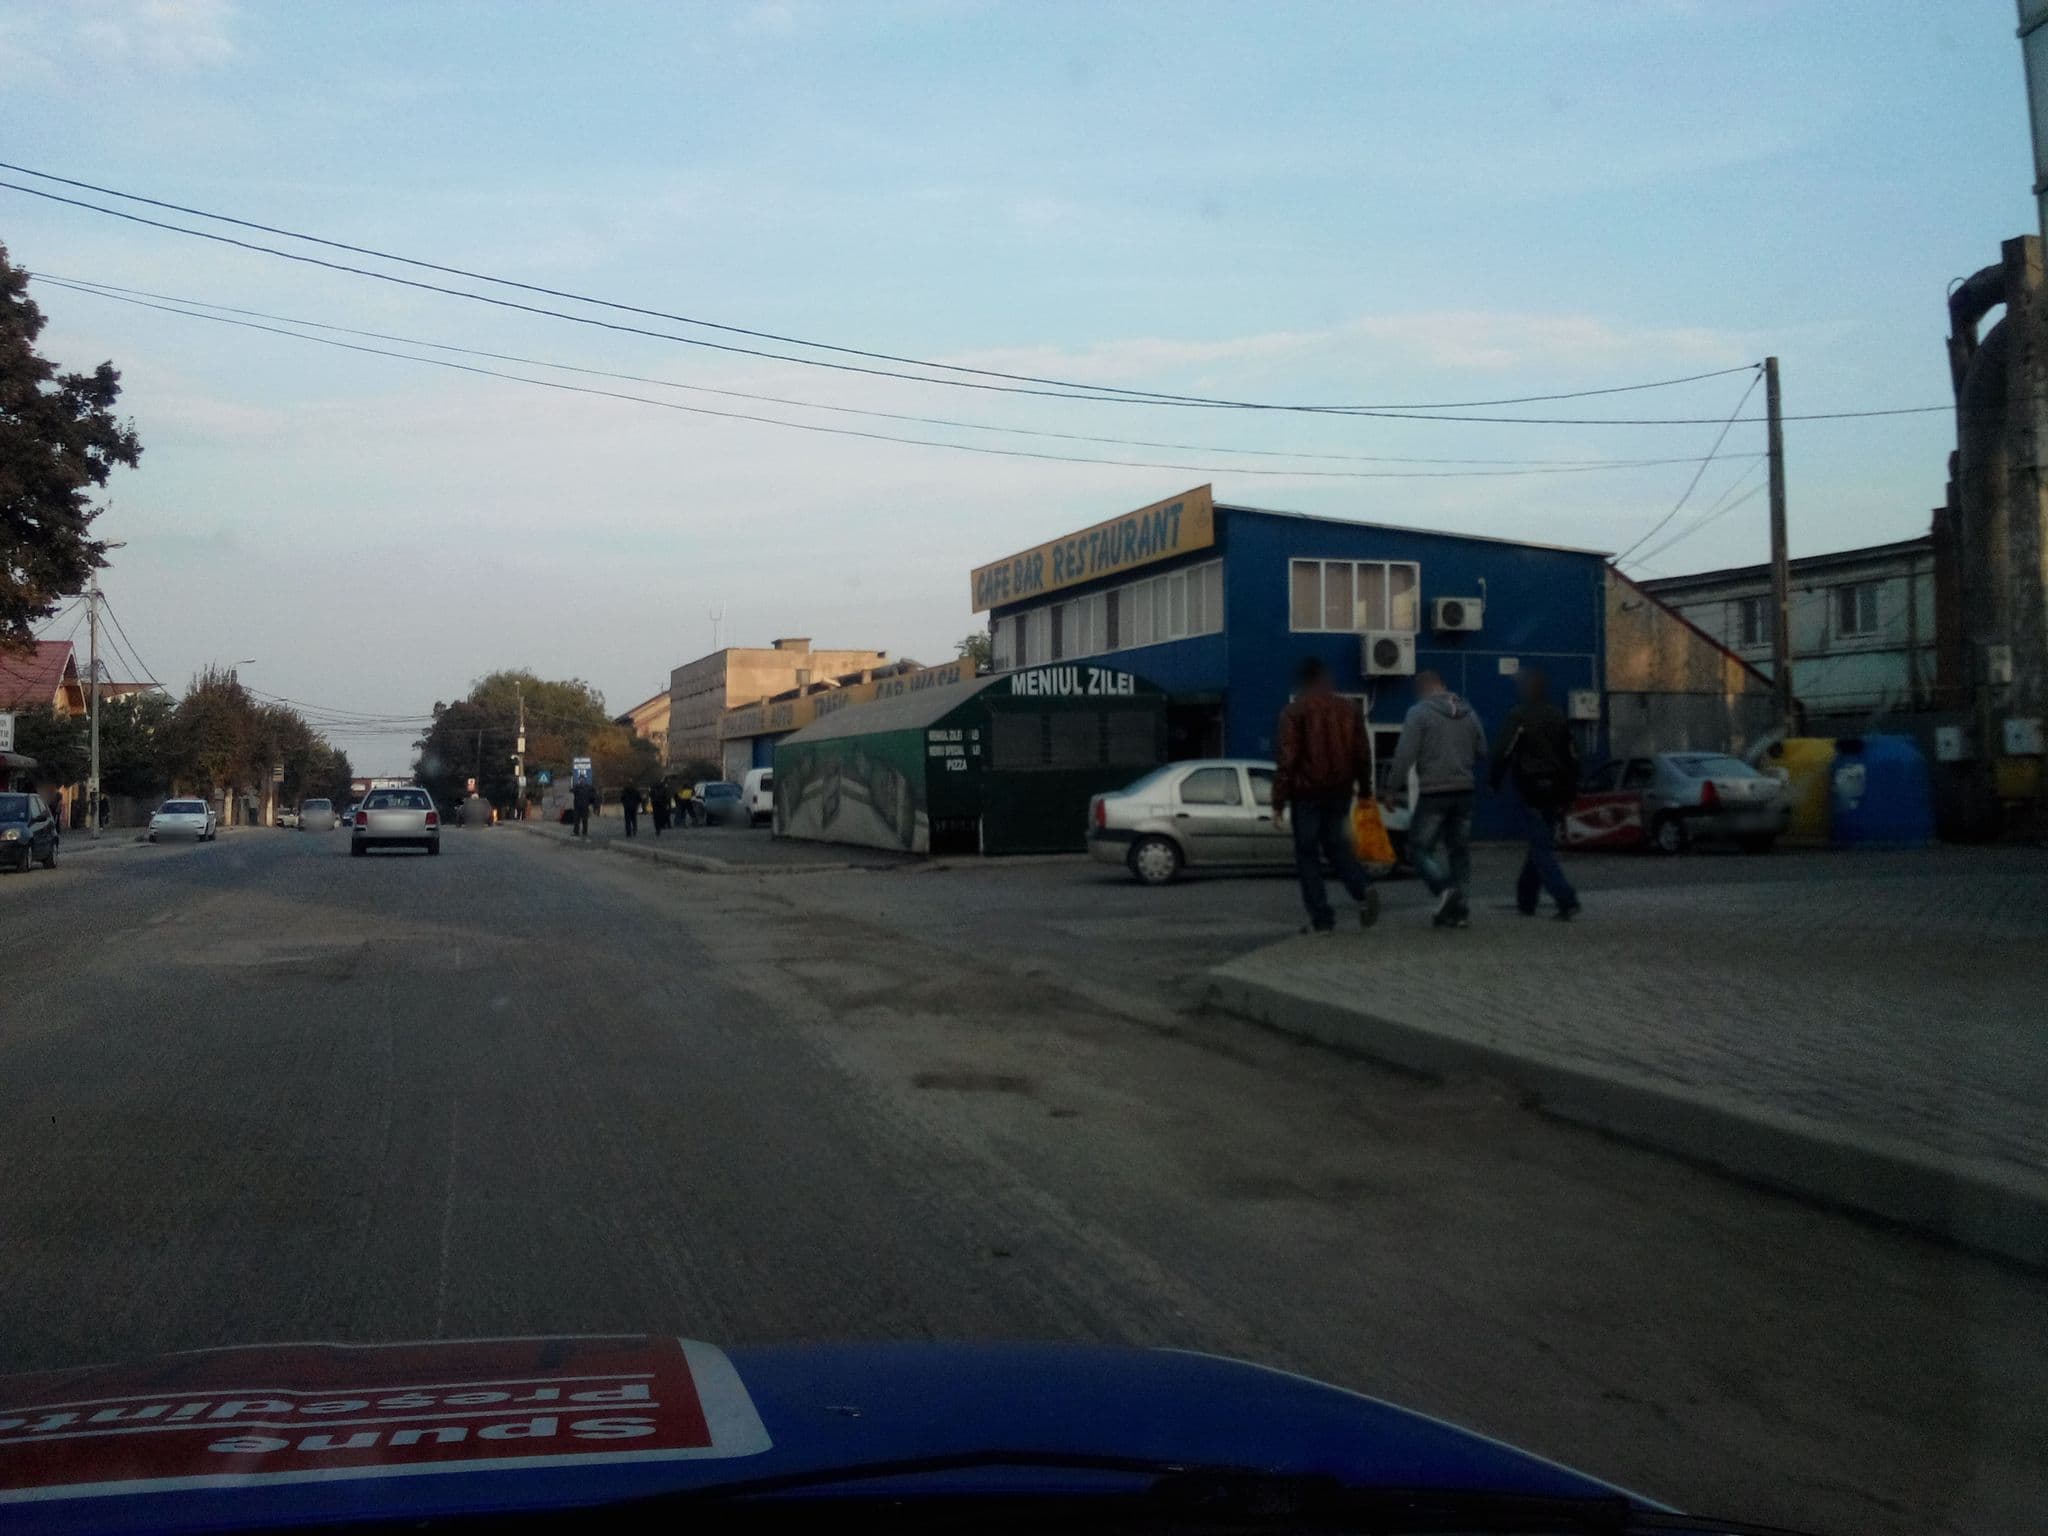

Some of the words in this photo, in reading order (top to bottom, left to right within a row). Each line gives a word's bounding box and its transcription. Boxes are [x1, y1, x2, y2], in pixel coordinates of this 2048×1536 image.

[976, 564, 1010, 605] CAFE
[1014, 552, 1045, 593] BAR
[1052, 503, 1184, 585] RESTAURANT
[1012, 666, 1083, 696] MENIUL
[1087, 667, 1135, 696] ZILEI
[946, 759, 968, 771] PIZZA
[207, 1416, 657, 1454] Spune
